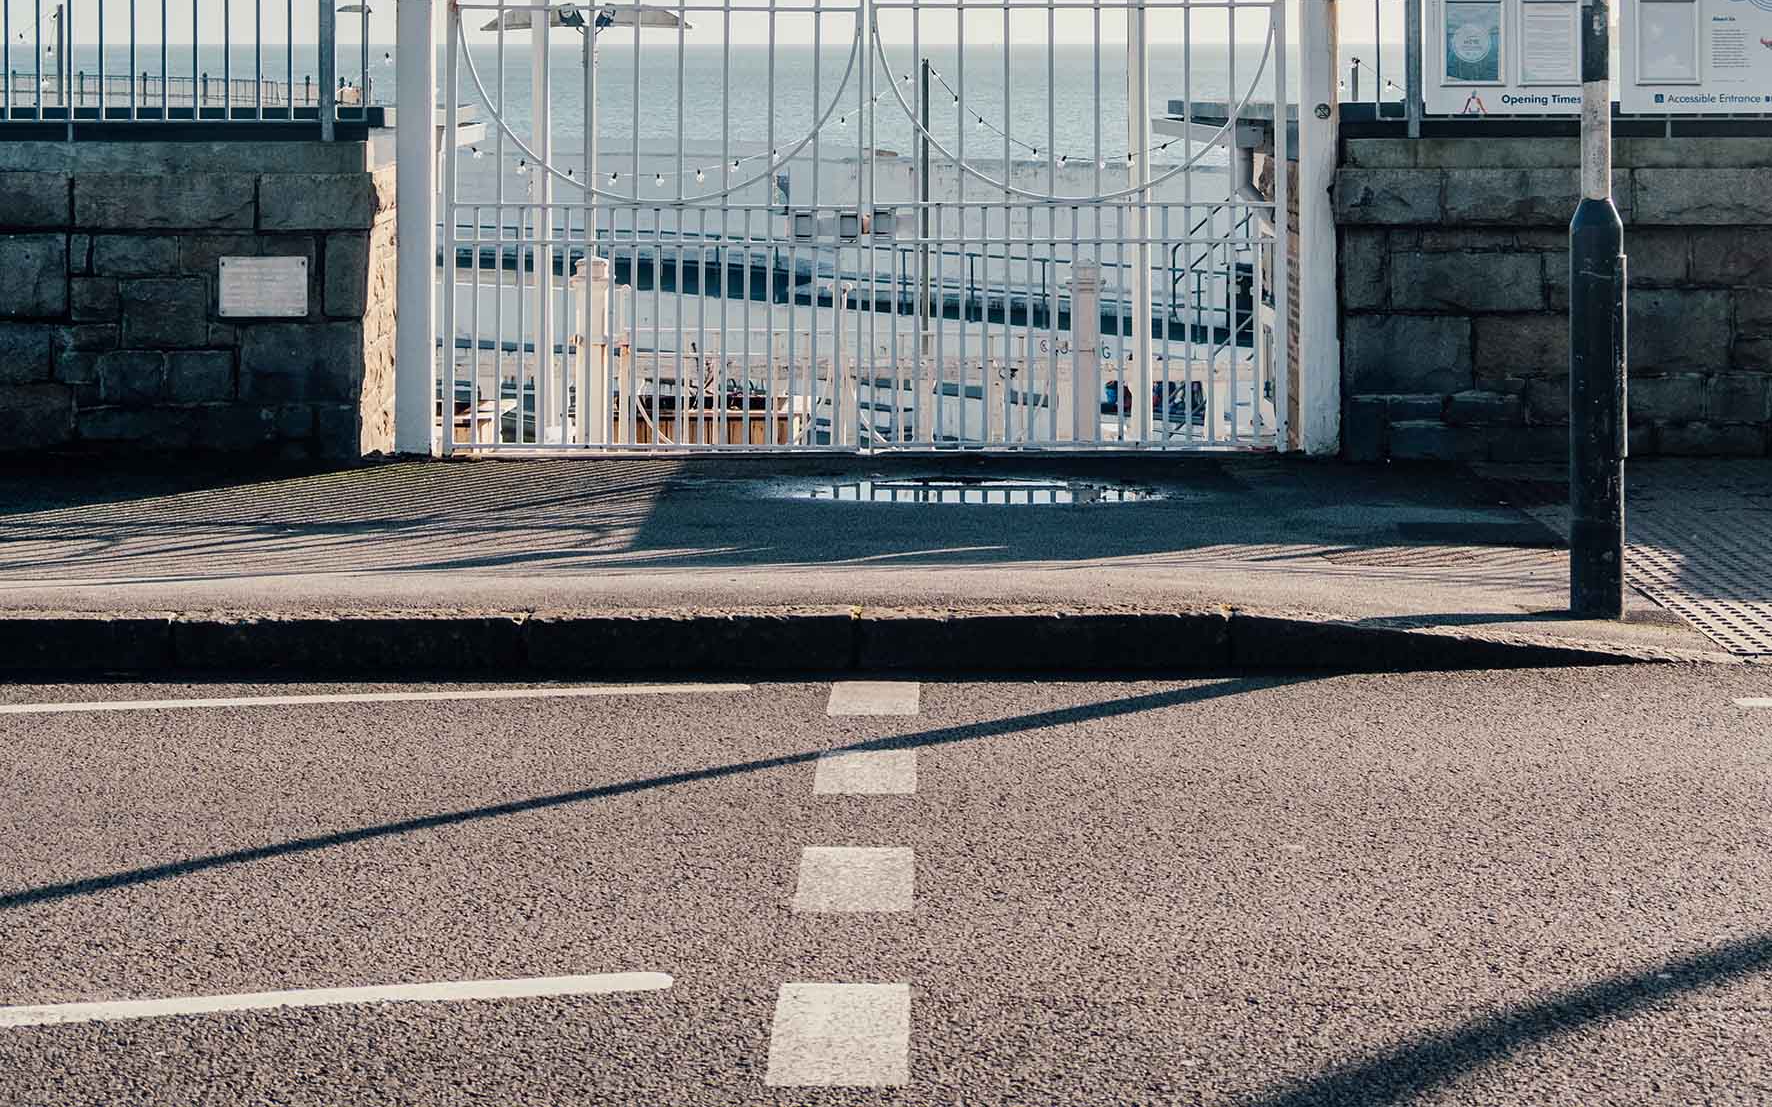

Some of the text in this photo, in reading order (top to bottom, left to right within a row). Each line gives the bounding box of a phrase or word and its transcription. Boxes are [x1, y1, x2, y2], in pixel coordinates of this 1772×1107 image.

[1501, 94, 1582, 106] Opening Times
[1668, 93, 1761, 103] Accessible Entrance
